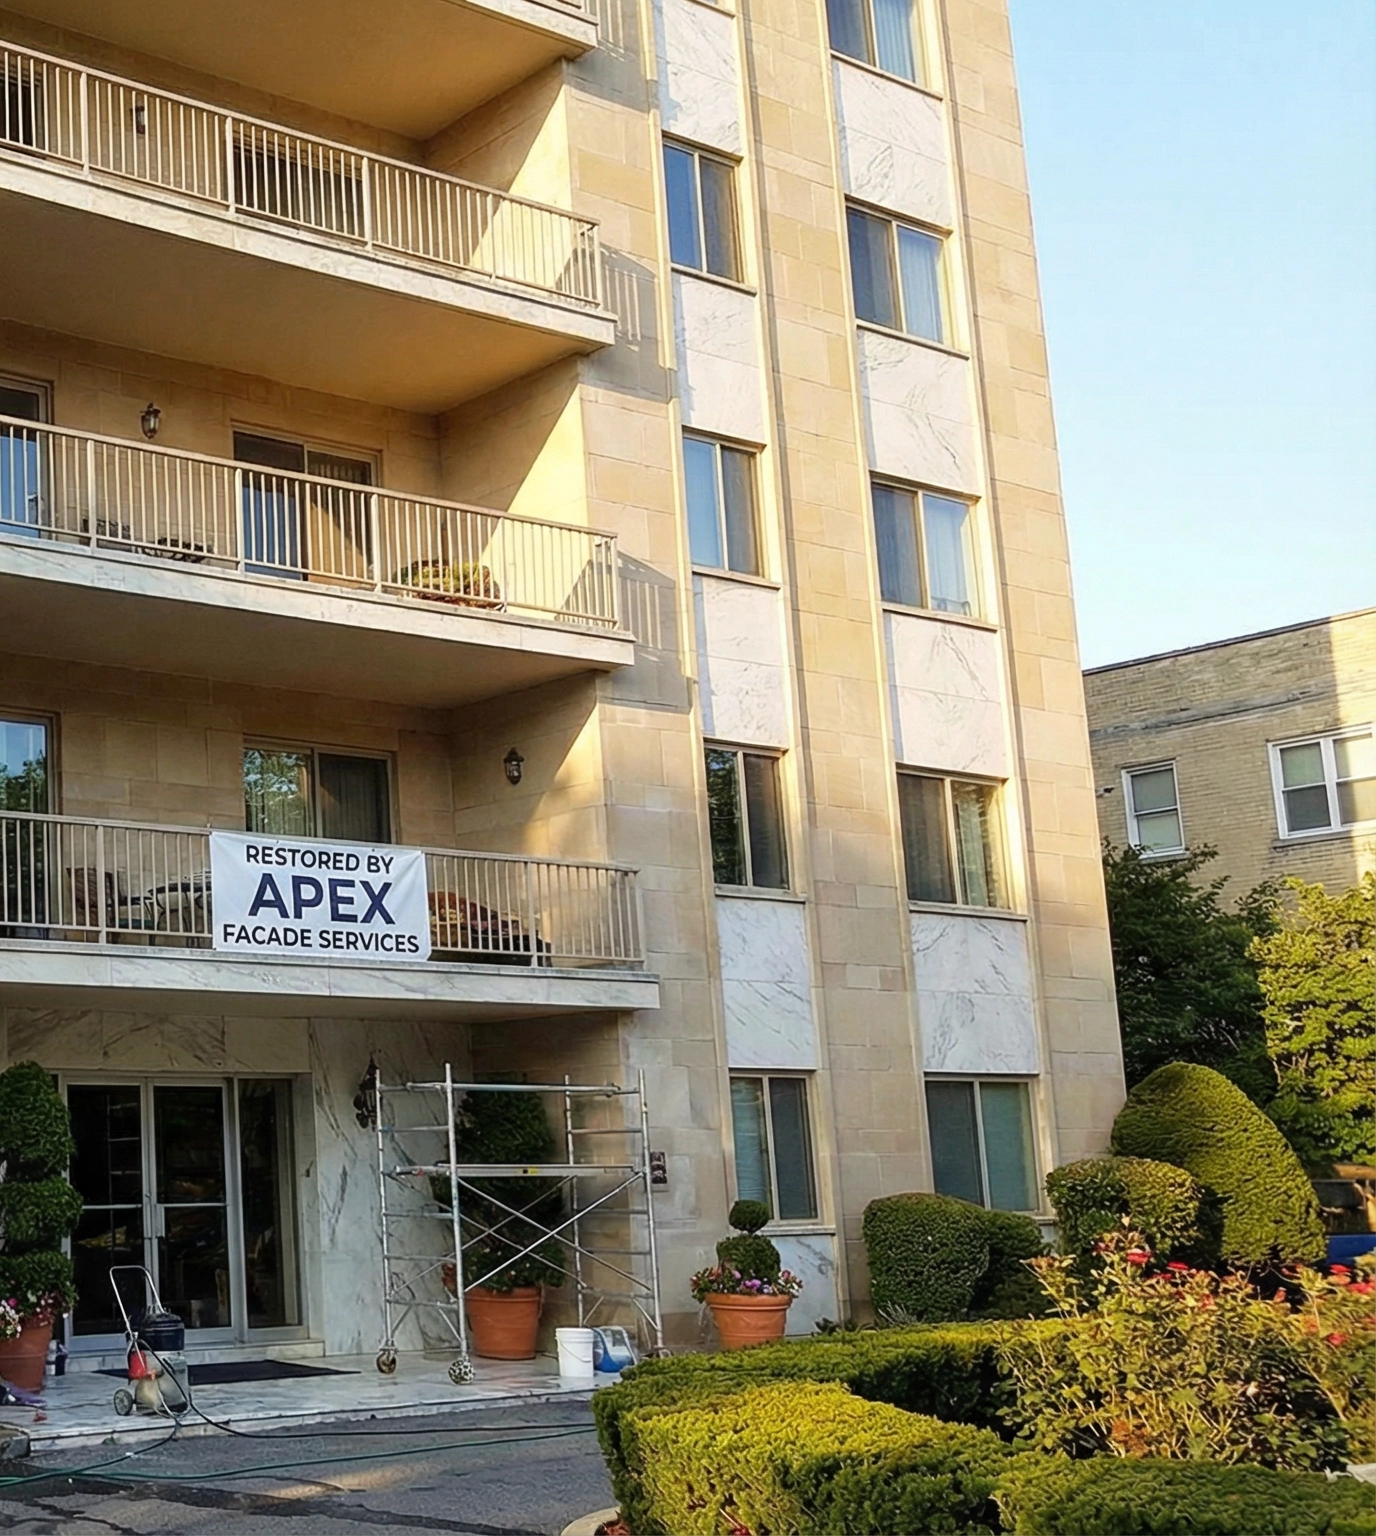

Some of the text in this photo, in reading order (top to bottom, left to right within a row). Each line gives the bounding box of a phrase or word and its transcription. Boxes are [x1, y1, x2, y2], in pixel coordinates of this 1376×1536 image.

[246, 845, 394, 874] RESTORED BY
[248, 873, 396, 925] APEX
[223, 924, 420, 953] FACADE SERVICES
